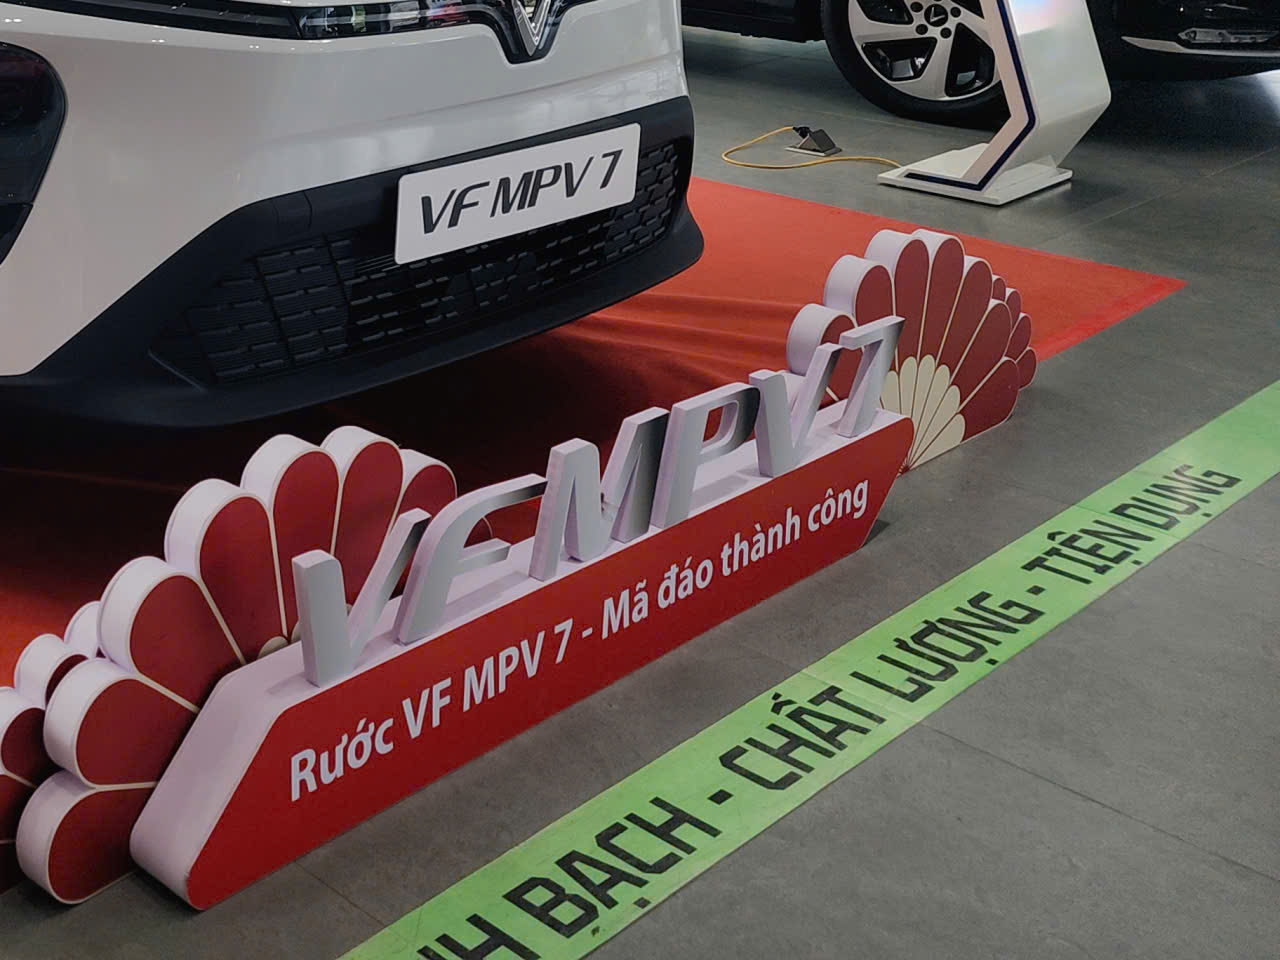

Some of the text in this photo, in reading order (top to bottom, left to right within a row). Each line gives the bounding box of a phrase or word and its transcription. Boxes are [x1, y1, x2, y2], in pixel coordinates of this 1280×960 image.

[421, 149, 624, 234] VF MPV 7
[289, 716, 395, 802] Rước
[402, 676, 453, 742] VF
[463, 633, 545, 712] MPV
[553, 617, 574, 665] 7
[600, 578, 649, 639] Mã
[656, 557, 714, 610] đáo
[720, 512, 801, 578] thành
[807, 478, 870, 533] công
[292, 315, 907, 688] VF MPV 7
[502, 796, 722, 939] BẠCH
[719, 686, 888, 791] CHẤT
[850, 591, 1046, 704] LƯỢNG
[1021, 519, 1156, 586] TIỆN
[1109, 463, 1243, 534] DỤNG
